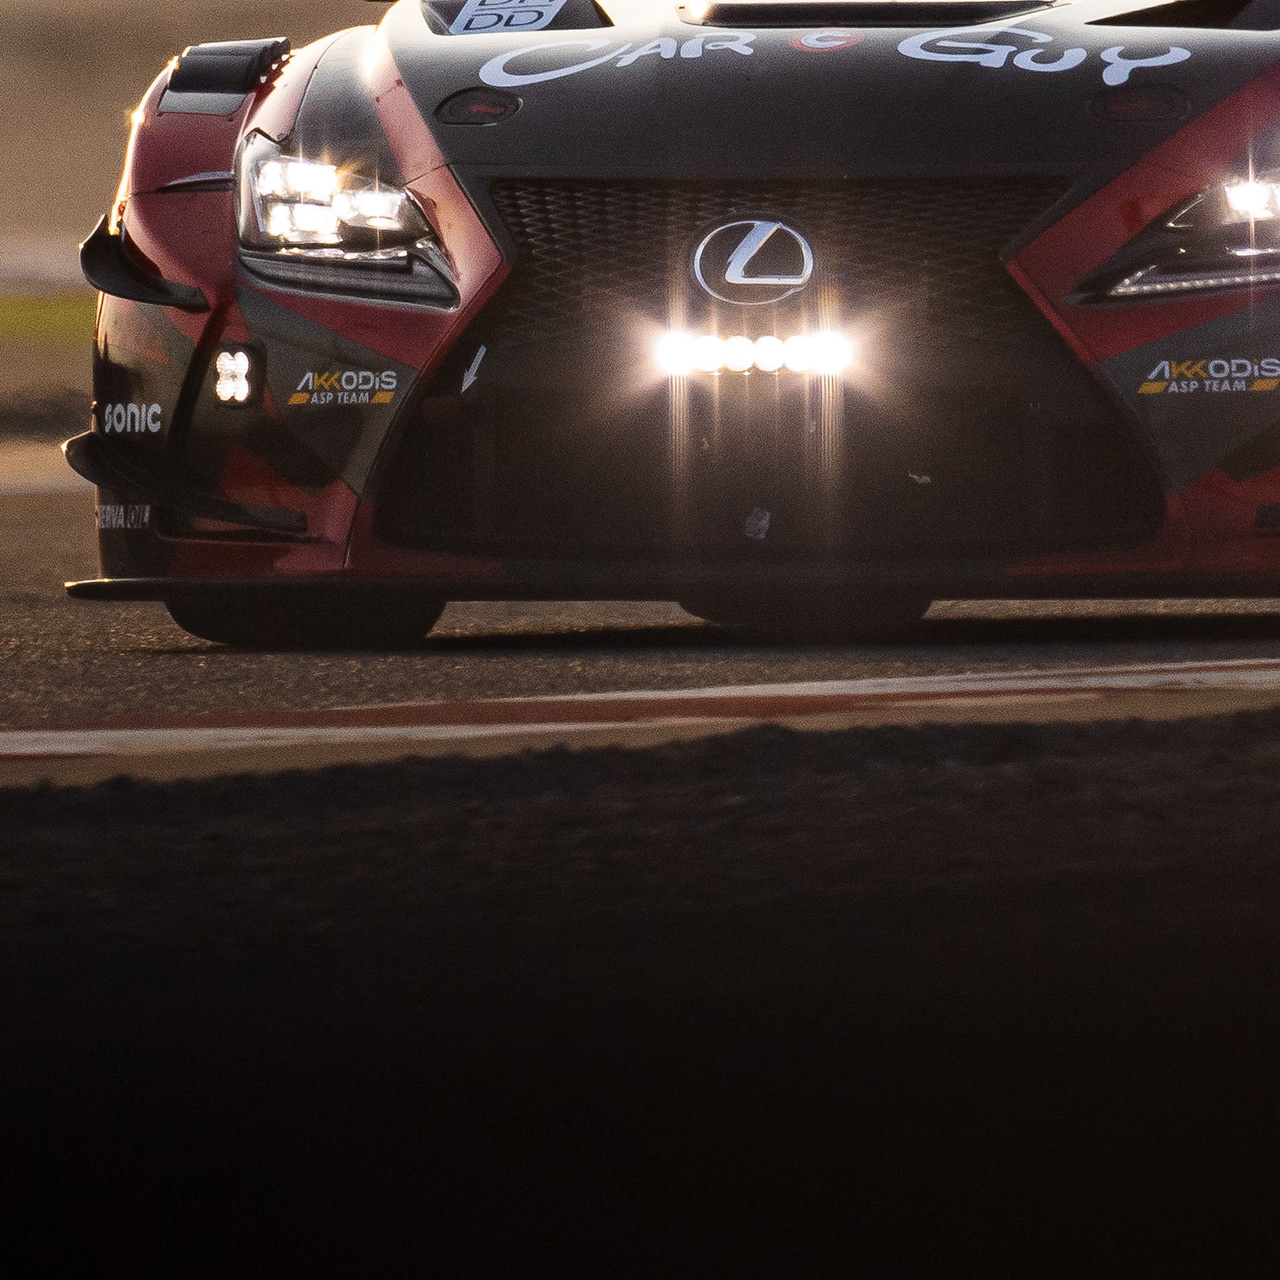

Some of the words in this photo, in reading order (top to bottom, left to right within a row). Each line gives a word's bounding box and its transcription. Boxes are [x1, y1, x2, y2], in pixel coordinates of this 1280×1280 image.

[478, 31, 755, 87] CAR
[897, 27, 1192, 86] GUY
[1168, 380, 1198, 393] ASP
[1203, 379, 1247, 392] TEAM
[310, 392, 333, 404] ASP
[337, 392, 369, 404] TEAM
